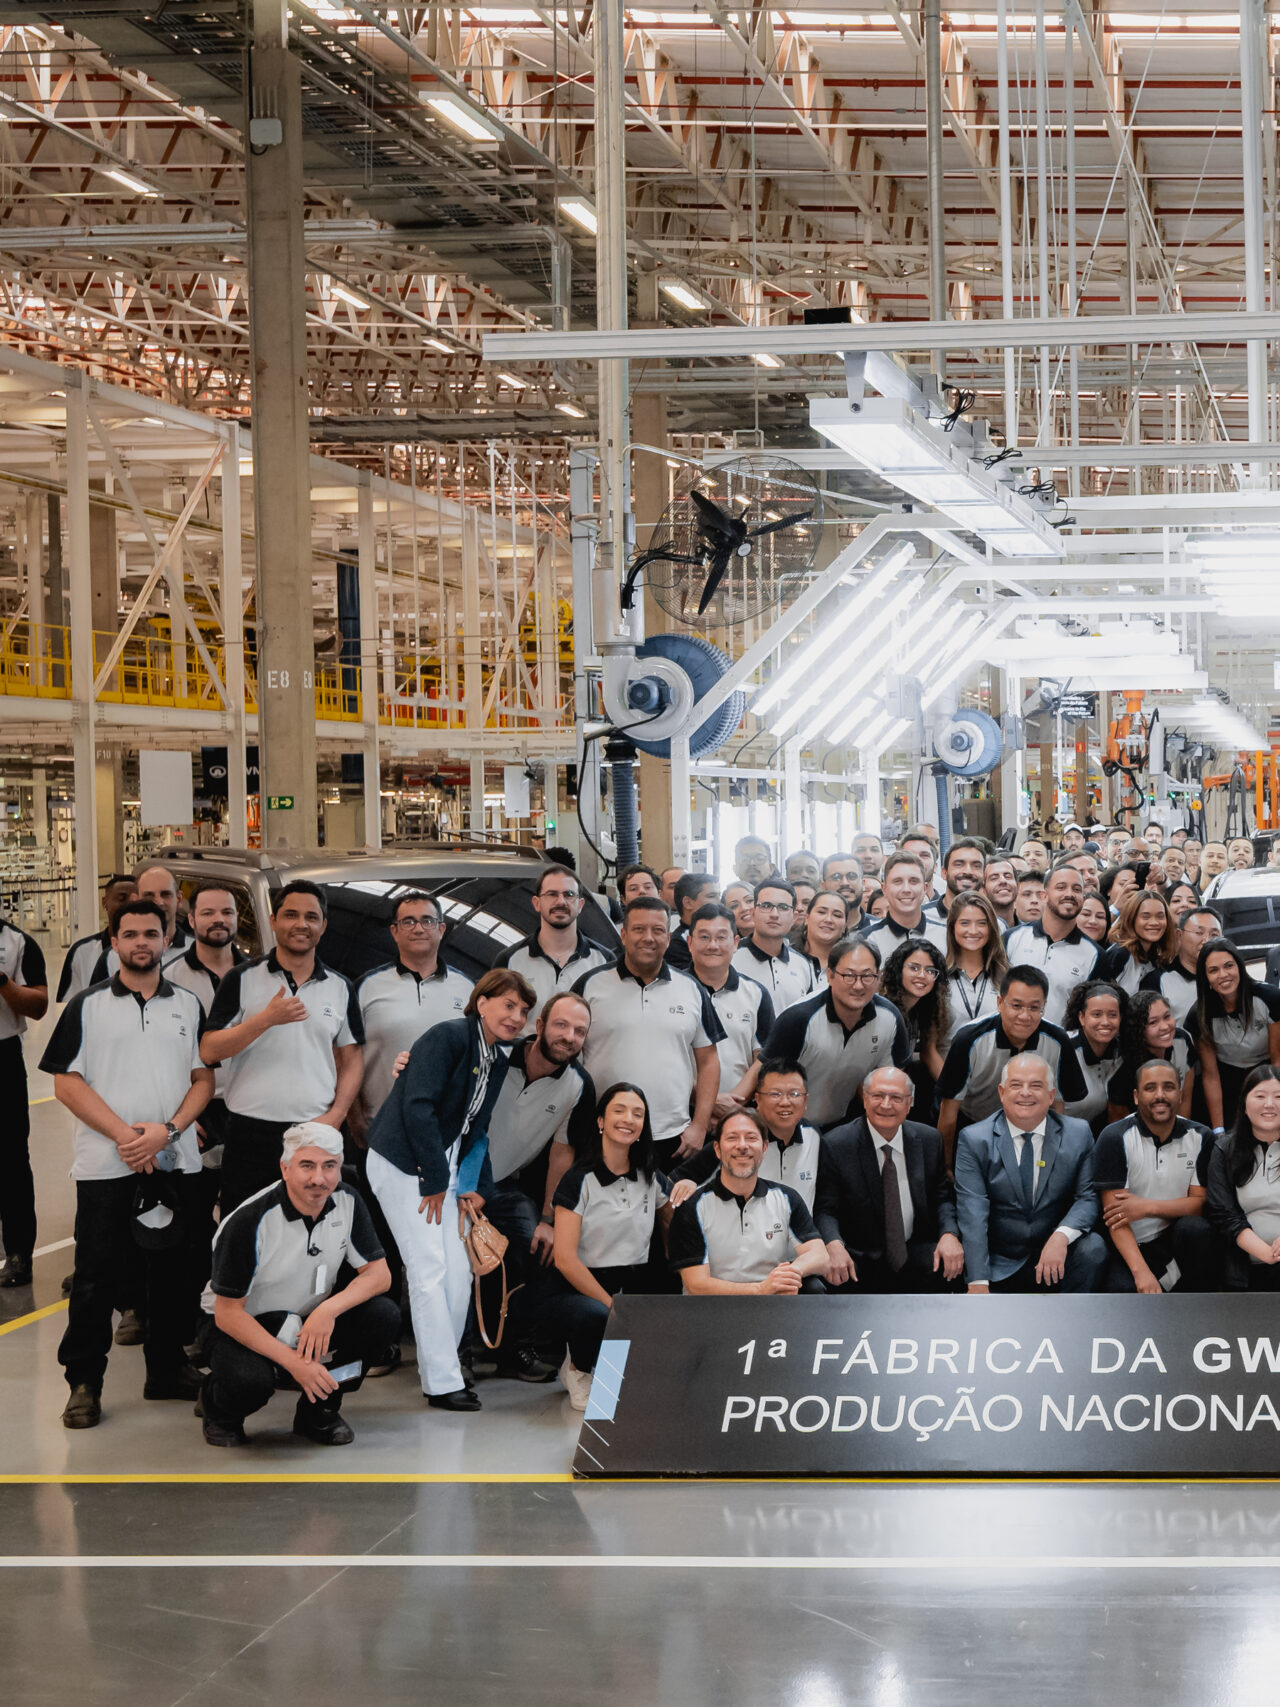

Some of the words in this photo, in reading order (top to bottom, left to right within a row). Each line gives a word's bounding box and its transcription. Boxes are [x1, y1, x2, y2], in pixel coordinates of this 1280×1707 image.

[267, 670, 290, 688] E8
[811, 1330, 1064, 1375] FÁBRICA
[1090, 1337, 1168, 1374] DA
[720, 1387, 1023, 1442] PRODUÇÃO
